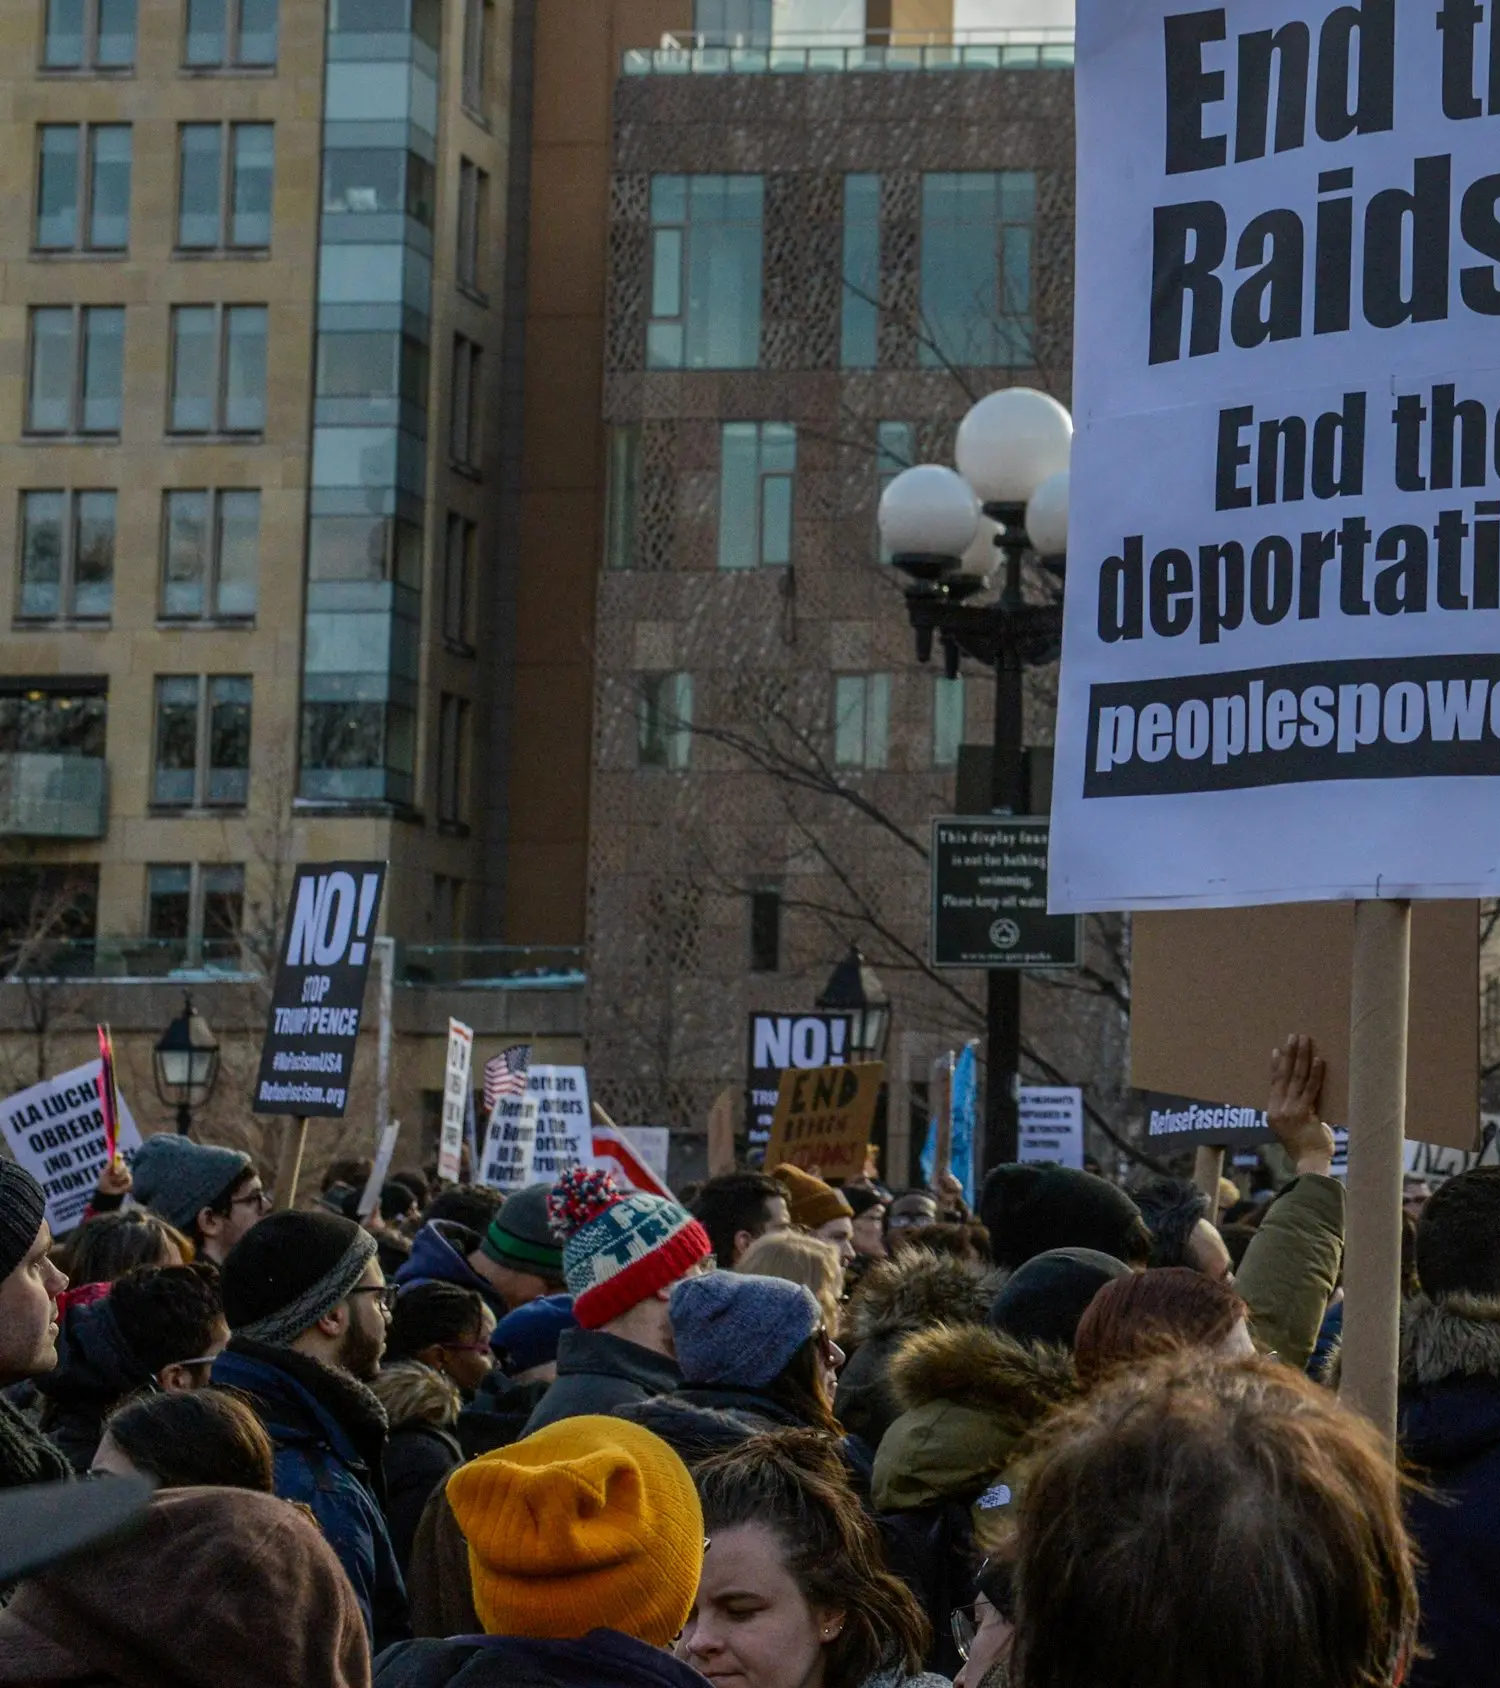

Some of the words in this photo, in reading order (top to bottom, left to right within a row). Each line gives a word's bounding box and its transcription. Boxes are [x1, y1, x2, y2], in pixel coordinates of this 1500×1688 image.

[1164, 0, 1395, 175] End
[1215, 393, 1366, 511] End
[286, 870, 378, 966] NO!
[301, 975, 331, 1003] STOP
[754, 1016, 847, 1069] NO!
[790, 1067, 858, 1113] END
